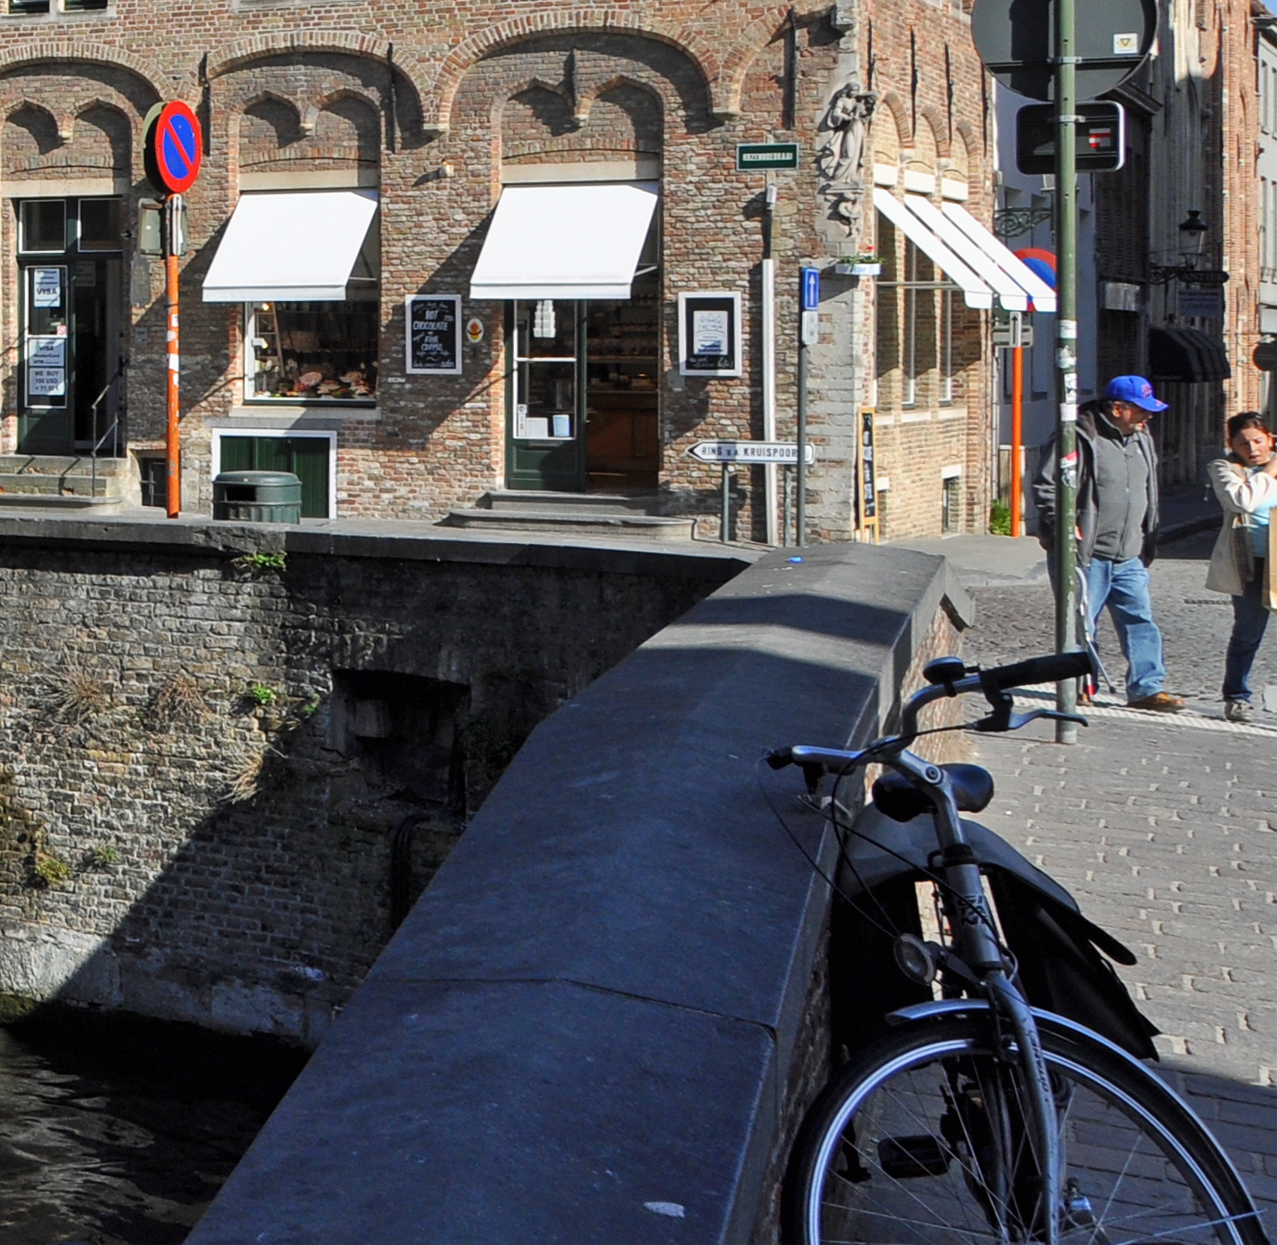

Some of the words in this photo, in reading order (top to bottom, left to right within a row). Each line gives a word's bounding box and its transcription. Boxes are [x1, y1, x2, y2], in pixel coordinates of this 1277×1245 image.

[413, 321, 448, 331] CHOCOLATE
[701, 447, 722, 456] RING
[743, 448, 799, 457] KRUISPOOR
